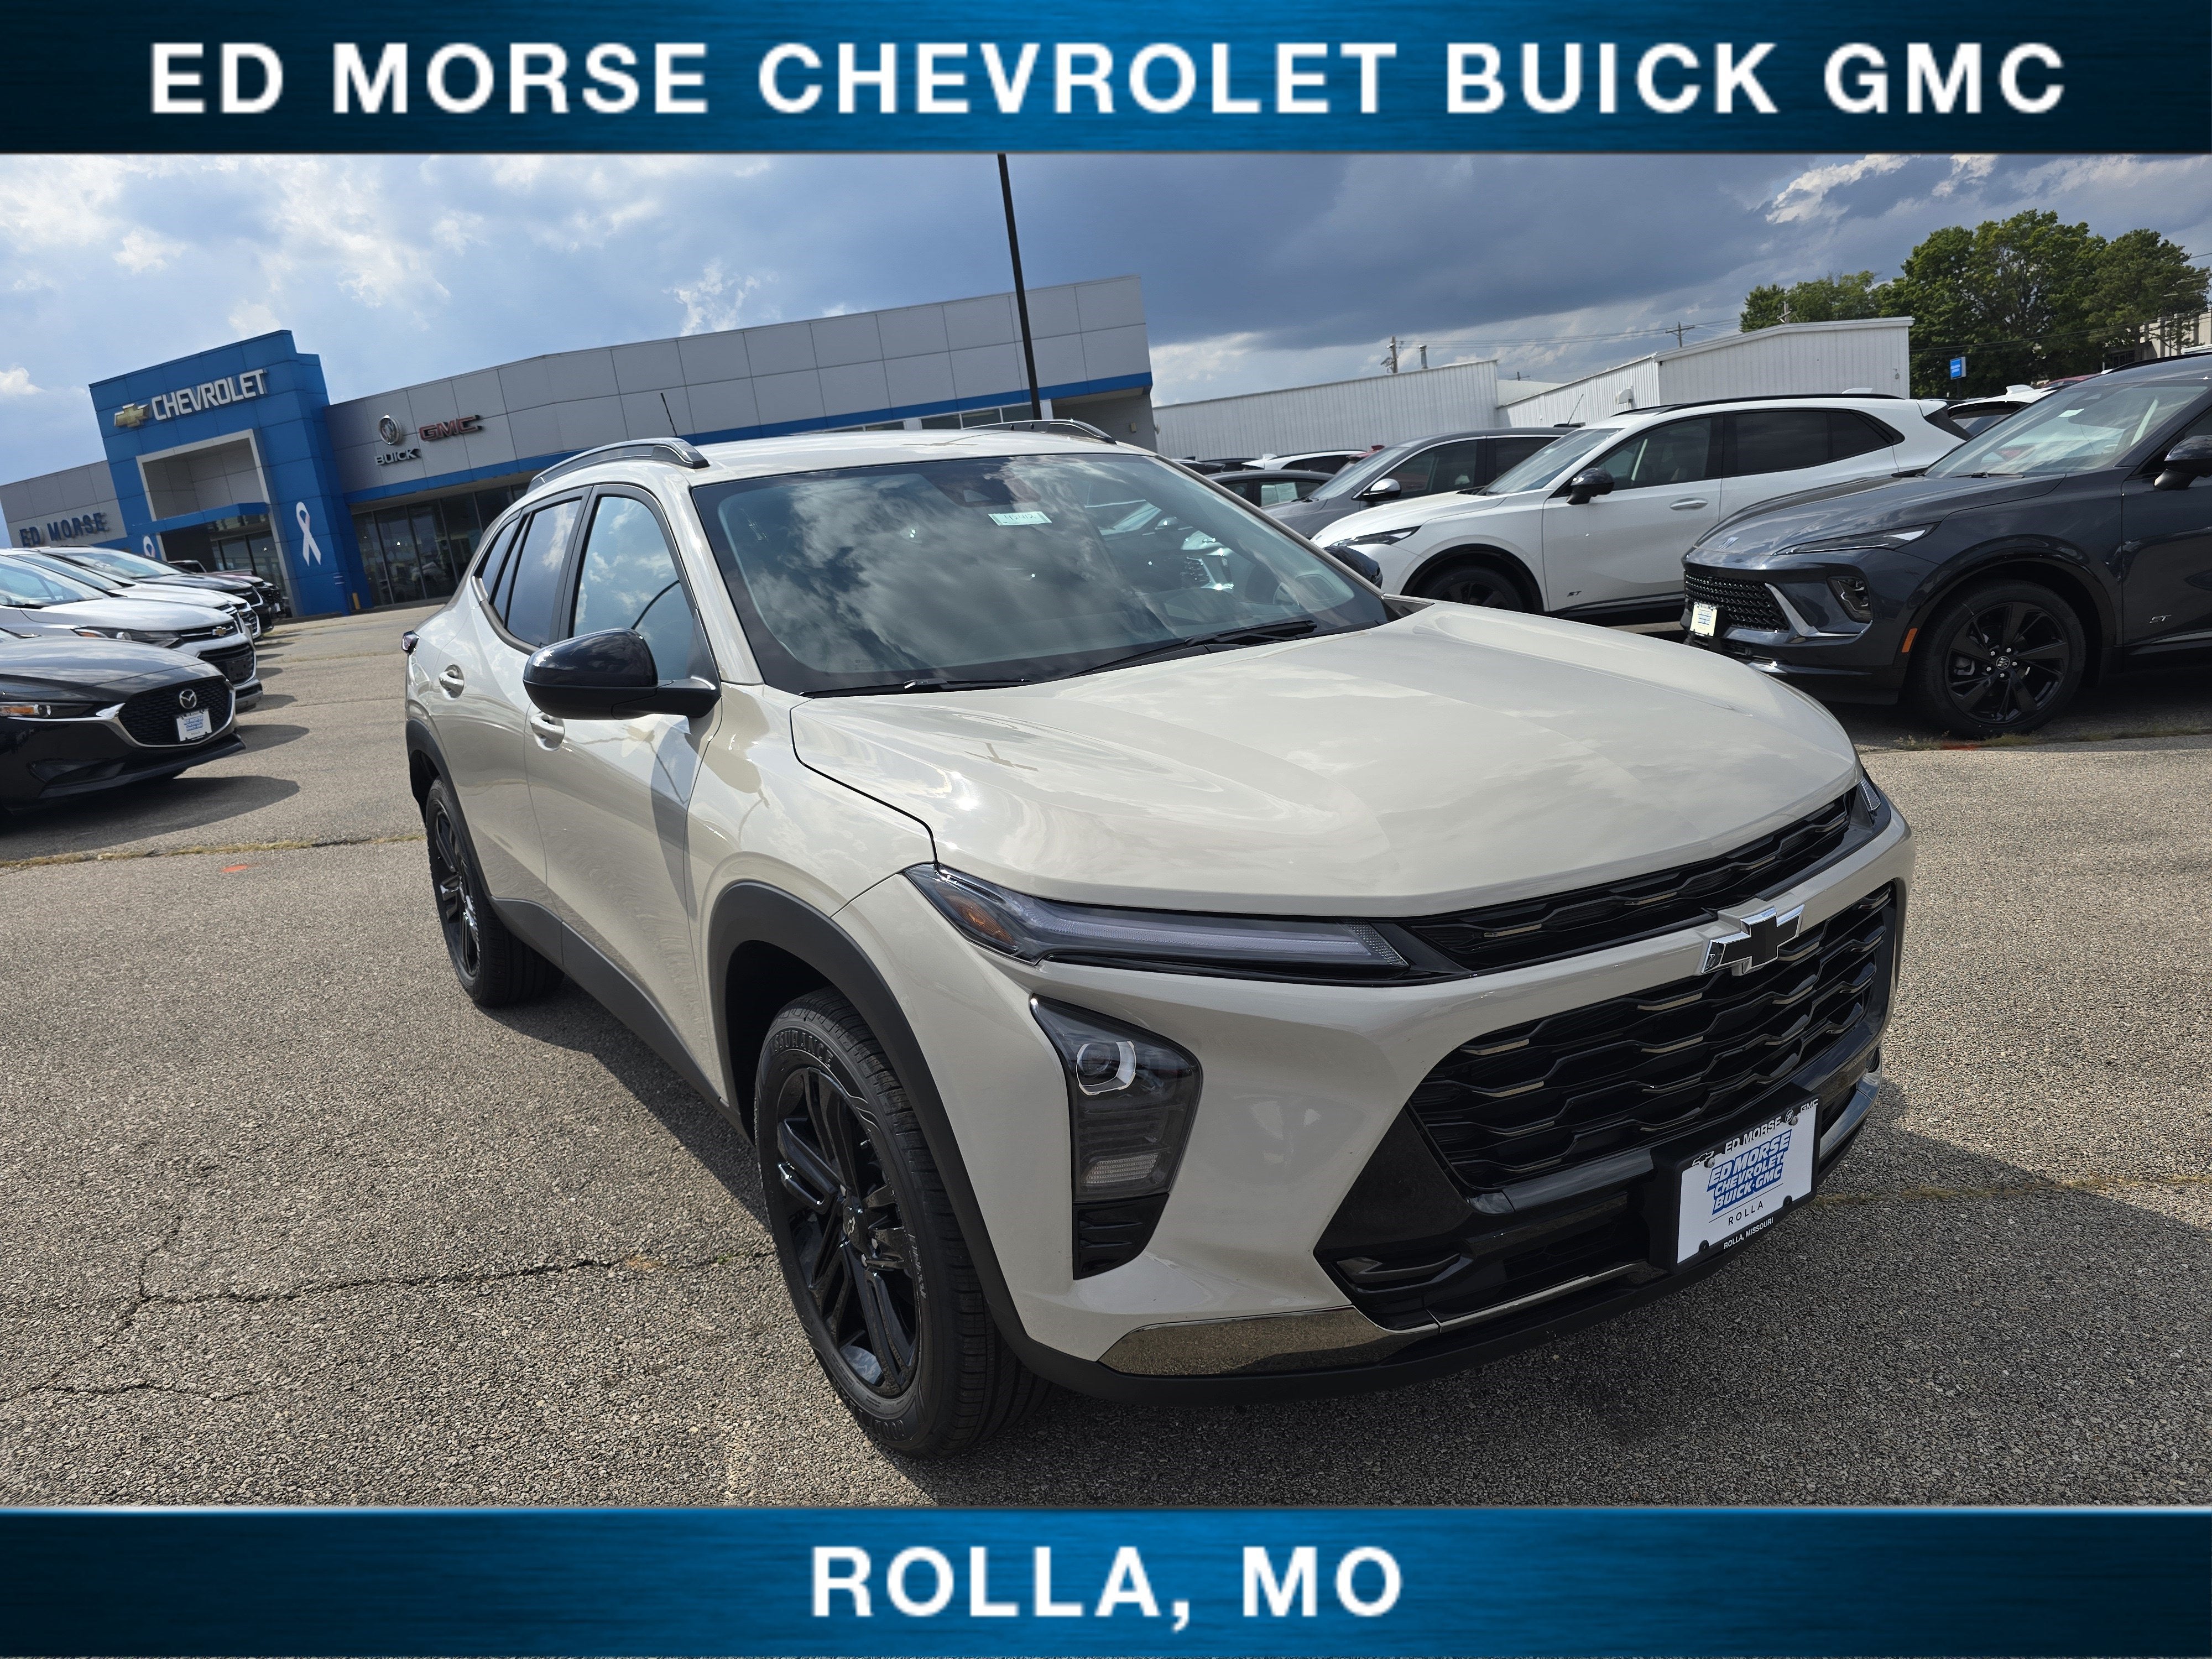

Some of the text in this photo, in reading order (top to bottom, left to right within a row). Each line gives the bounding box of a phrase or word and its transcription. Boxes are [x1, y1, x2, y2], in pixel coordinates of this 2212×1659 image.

[152, 368, 265, 421] CHEVROLET
[419, 415, 481, 441] GMC
[374, 449, 419, 465] BUICK
[19, 512, 108, 547] ED MORSE
[1725, 1098, 1819, 1154] ED MORSE GMC
[1708, 1129, 1792, 1188] ED MORSE
[1714, 1151, 1784, 1197] CHEVROLET
[1728, 1201, 1763, 1226] ROLLA
[1723, 1217, 1773, 1250] ROLLA, MISSOURI
